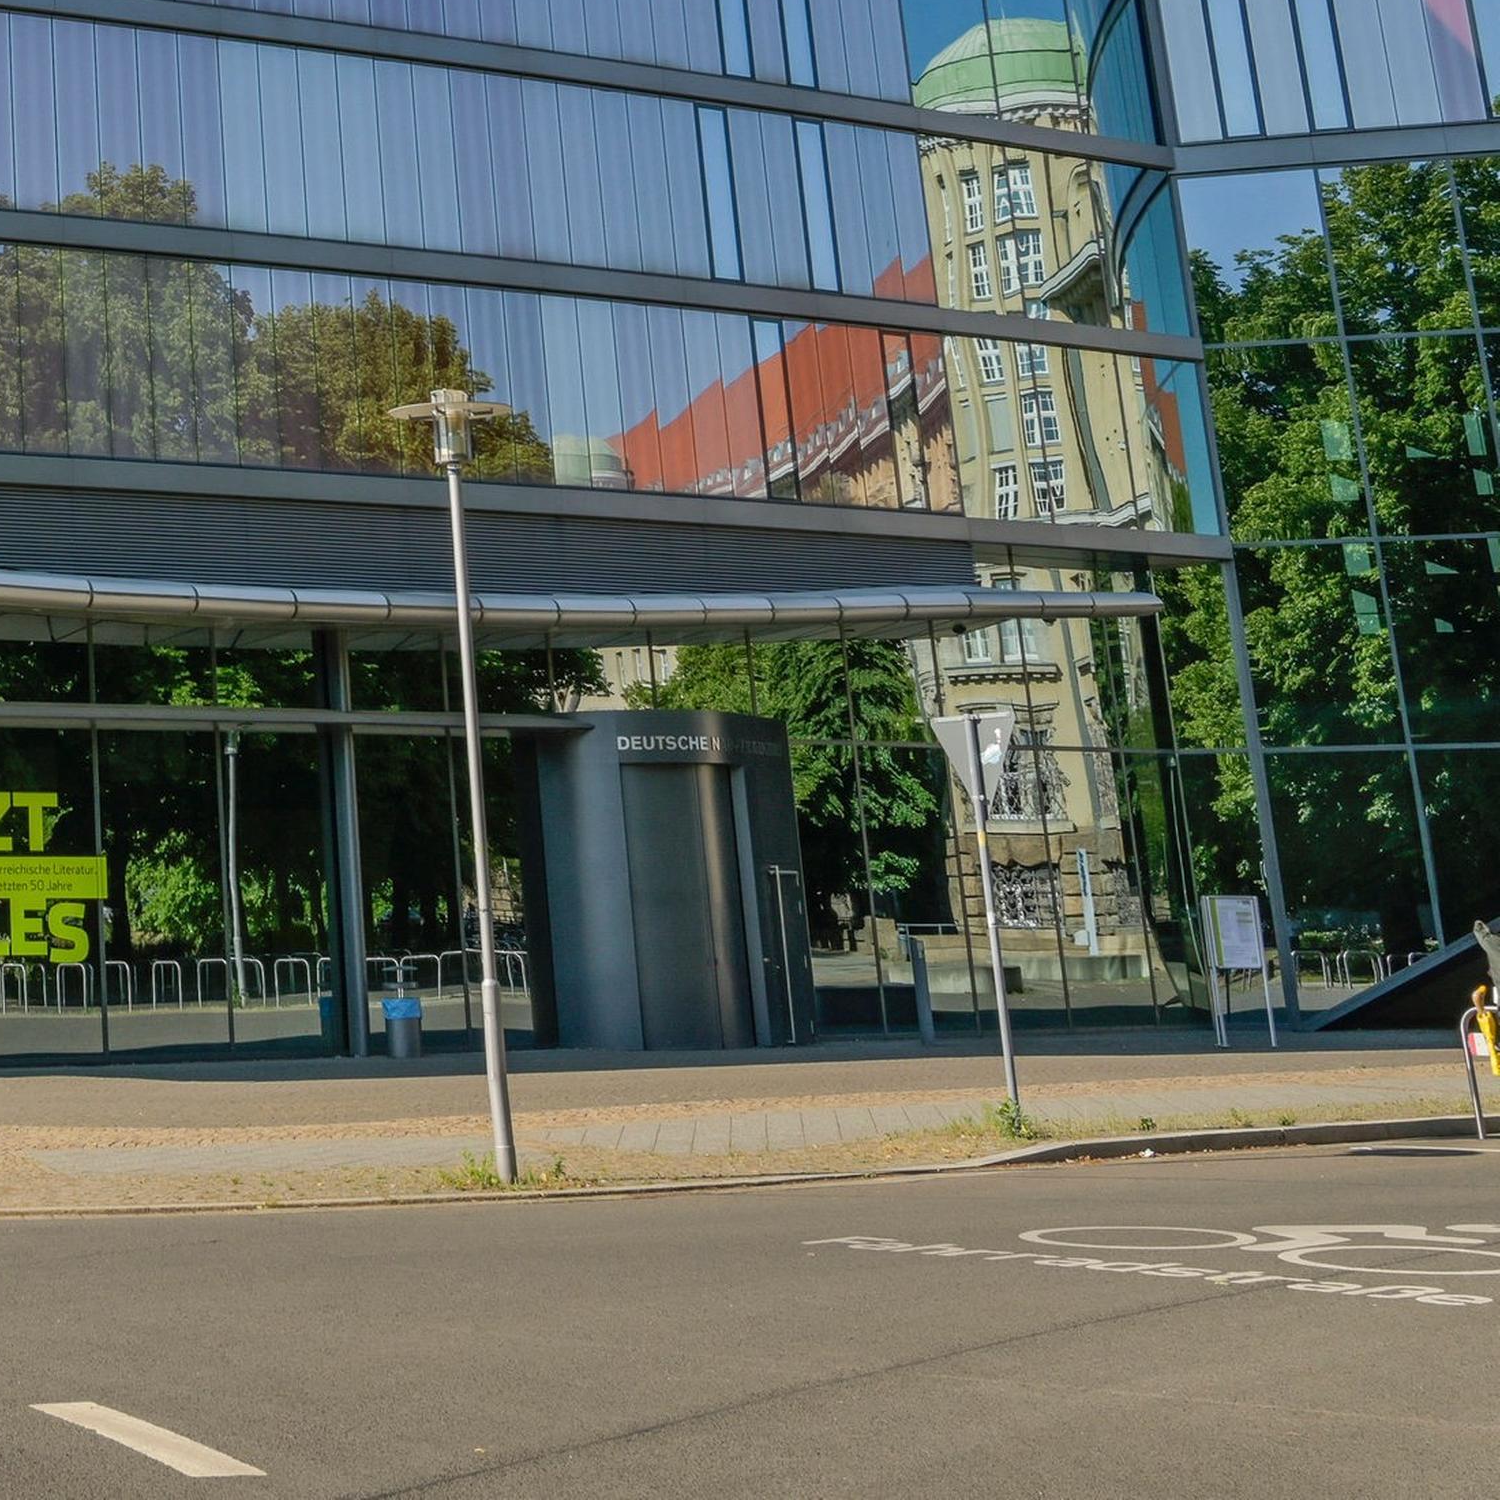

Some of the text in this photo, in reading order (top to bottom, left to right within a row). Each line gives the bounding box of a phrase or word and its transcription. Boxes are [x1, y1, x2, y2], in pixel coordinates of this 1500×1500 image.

[617, 735, 708, 751] DEUTSCHE
[30, 880, 44, 891] 50
[46, 880, 73, 891] Jahre
[800, 1236, 1493, 1306] Fahrradstraße
